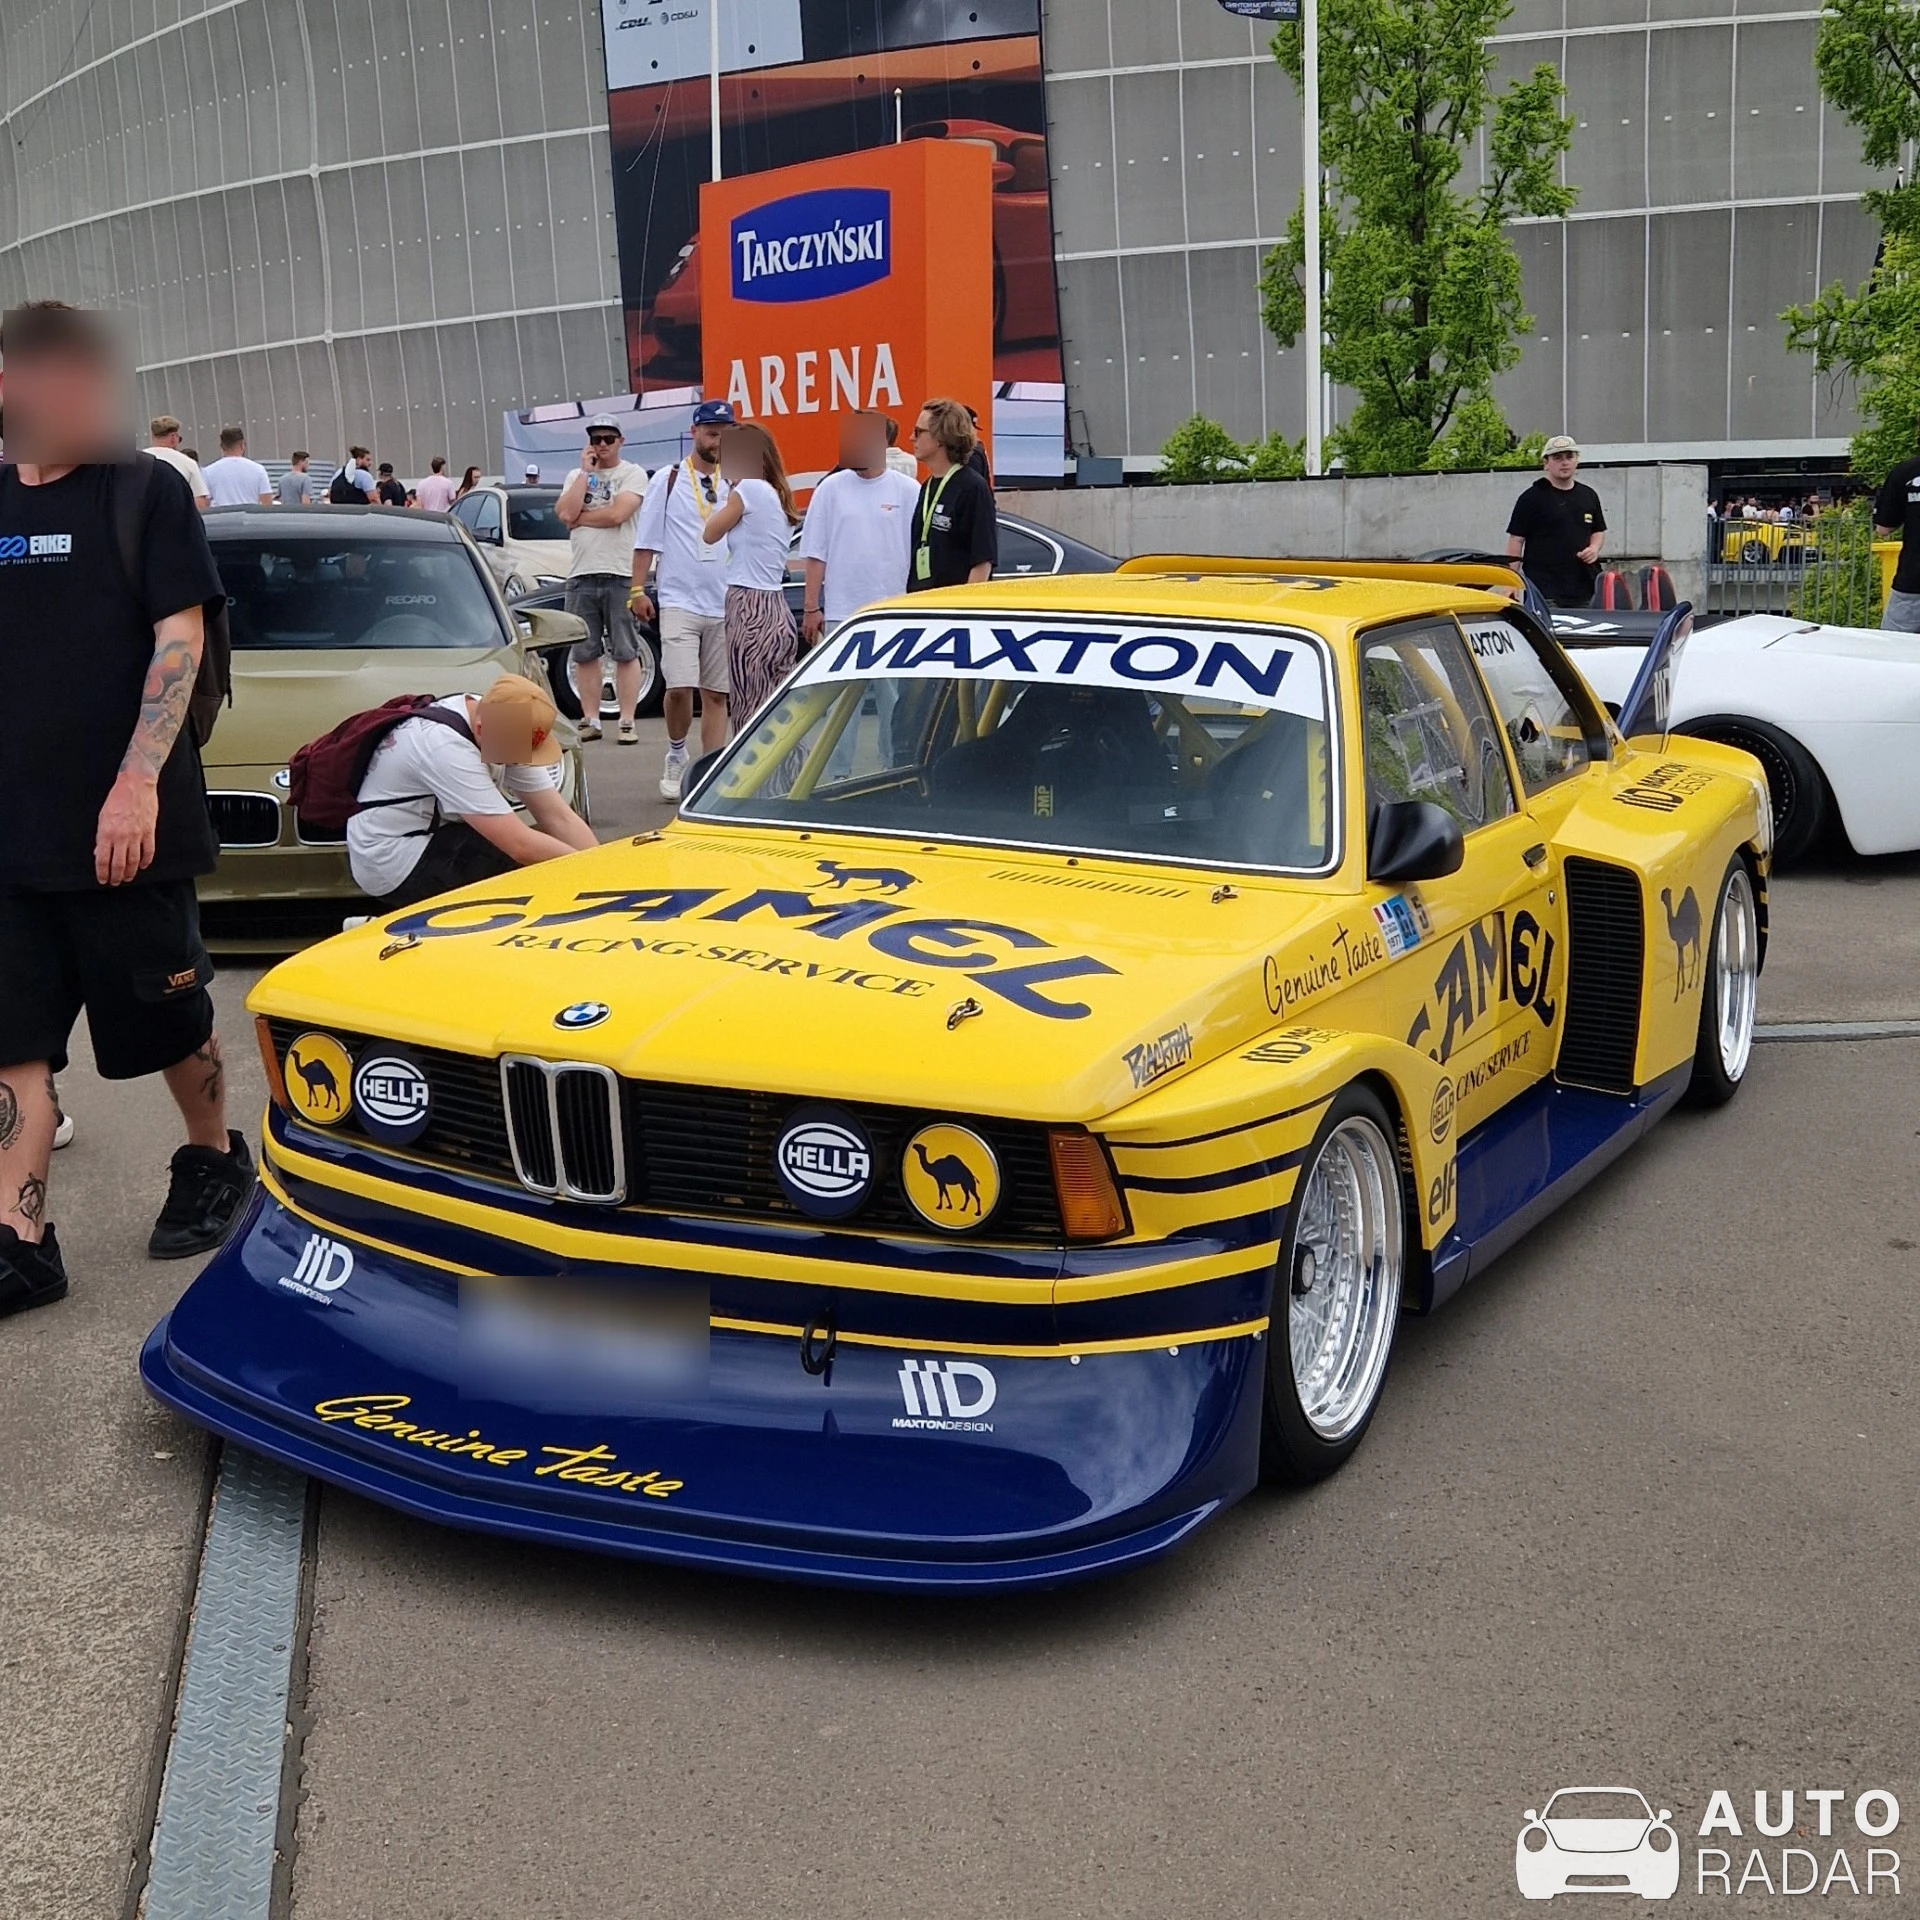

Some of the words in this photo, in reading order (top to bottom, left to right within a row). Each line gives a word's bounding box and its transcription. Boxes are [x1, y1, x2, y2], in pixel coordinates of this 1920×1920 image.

[727, 342, 903, 419] ARENA
[386, 595, 437, 604] RECARO
[828, 627, 1293, 698] MAXTON
[1466, 630, 1516, 657] AXTON
[383, 887, 1123, 1021] CAMEL
[492, 932, 701, 962] RACING
[697, 945, 939, 998] SERVICE
[1264, 955, 1341, 1019] Genuine
[1332, 923, 1382, 976] Taste
[1485, 1030, 1531, 1081] SERVICE
[358, 1075, 429, 1107] HELLA
[1432, 1091, 1455, 1124] HELLA
[785, 1142, 870, 1180] HELLA
[314, 1392, 528, 1468] Genuine
[532, 1444, 686, 1499] Taste
